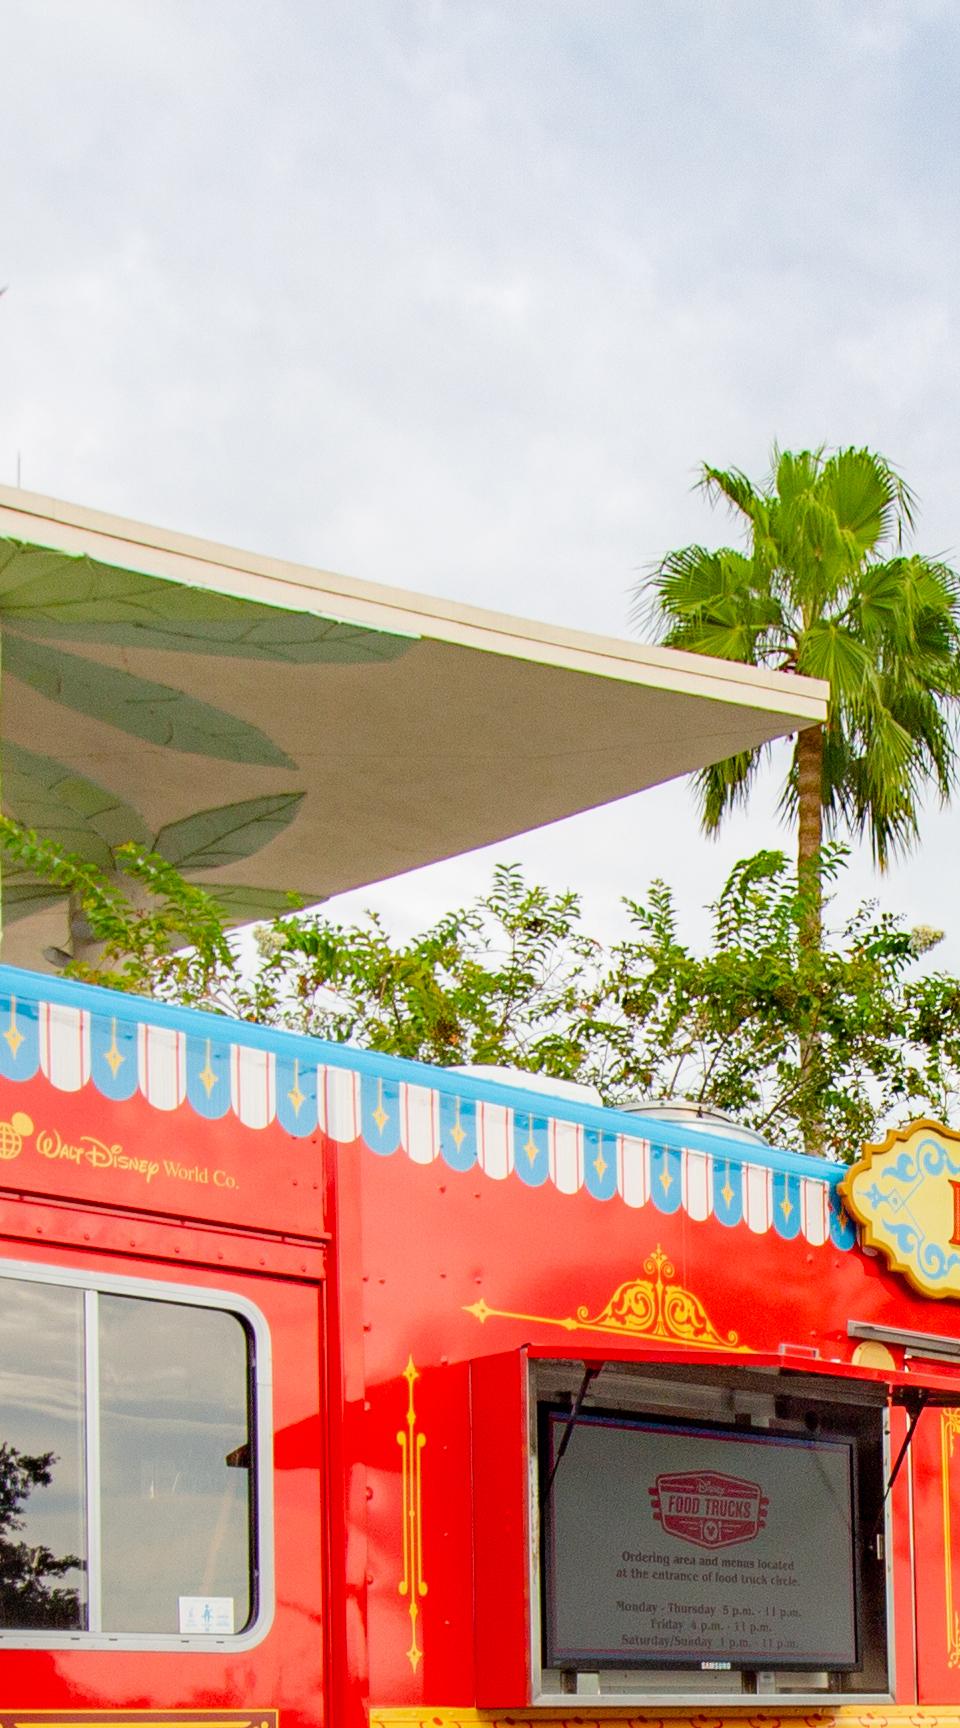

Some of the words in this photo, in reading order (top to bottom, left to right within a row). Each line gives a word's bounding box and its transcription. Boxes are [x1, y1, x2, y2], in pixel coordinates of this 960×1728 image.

[162, 1159, 208, 1184] World
[213, 1170, 240, 1189] Co.
[668, 1494, 700, 1515] FOOD
[704, 1498, 752, 1519] TRUCKS
[621, 1550, 670, 1567] Ordering
[673, 1555, 696, 1565] area
[699, 1555, 718, 1567] and
[721, 1558, 755, 1569] menus
[757, 1558, 795, 1571] located
[616, 1567, 628, 1578] at
[631, 1568, 649, 1579] the
[652, 1570, 697, 1582] entrance
[702, 1571, 713, 1582] of
[715, 1572, 738, 1584] food
[741, 1573, 767, 1585] truck
[770, 1575, 800, 1587] circle.
[616, 1600, 658, 1615] Monday
[667, 1602, 717, 1617] Thursday
[732, 1606, 755, 1618] p.m.
[779, 1608, 802, 1618] p.m.
[650, 1618, 683, 1631] Friday
[700, 1621, 724, 1633] p.m.
[750, 1623, 772, 1634] p.m.
[728, 1637, 752, 1649] p.m.
[776, 1639, 799, 1650] p.m.
